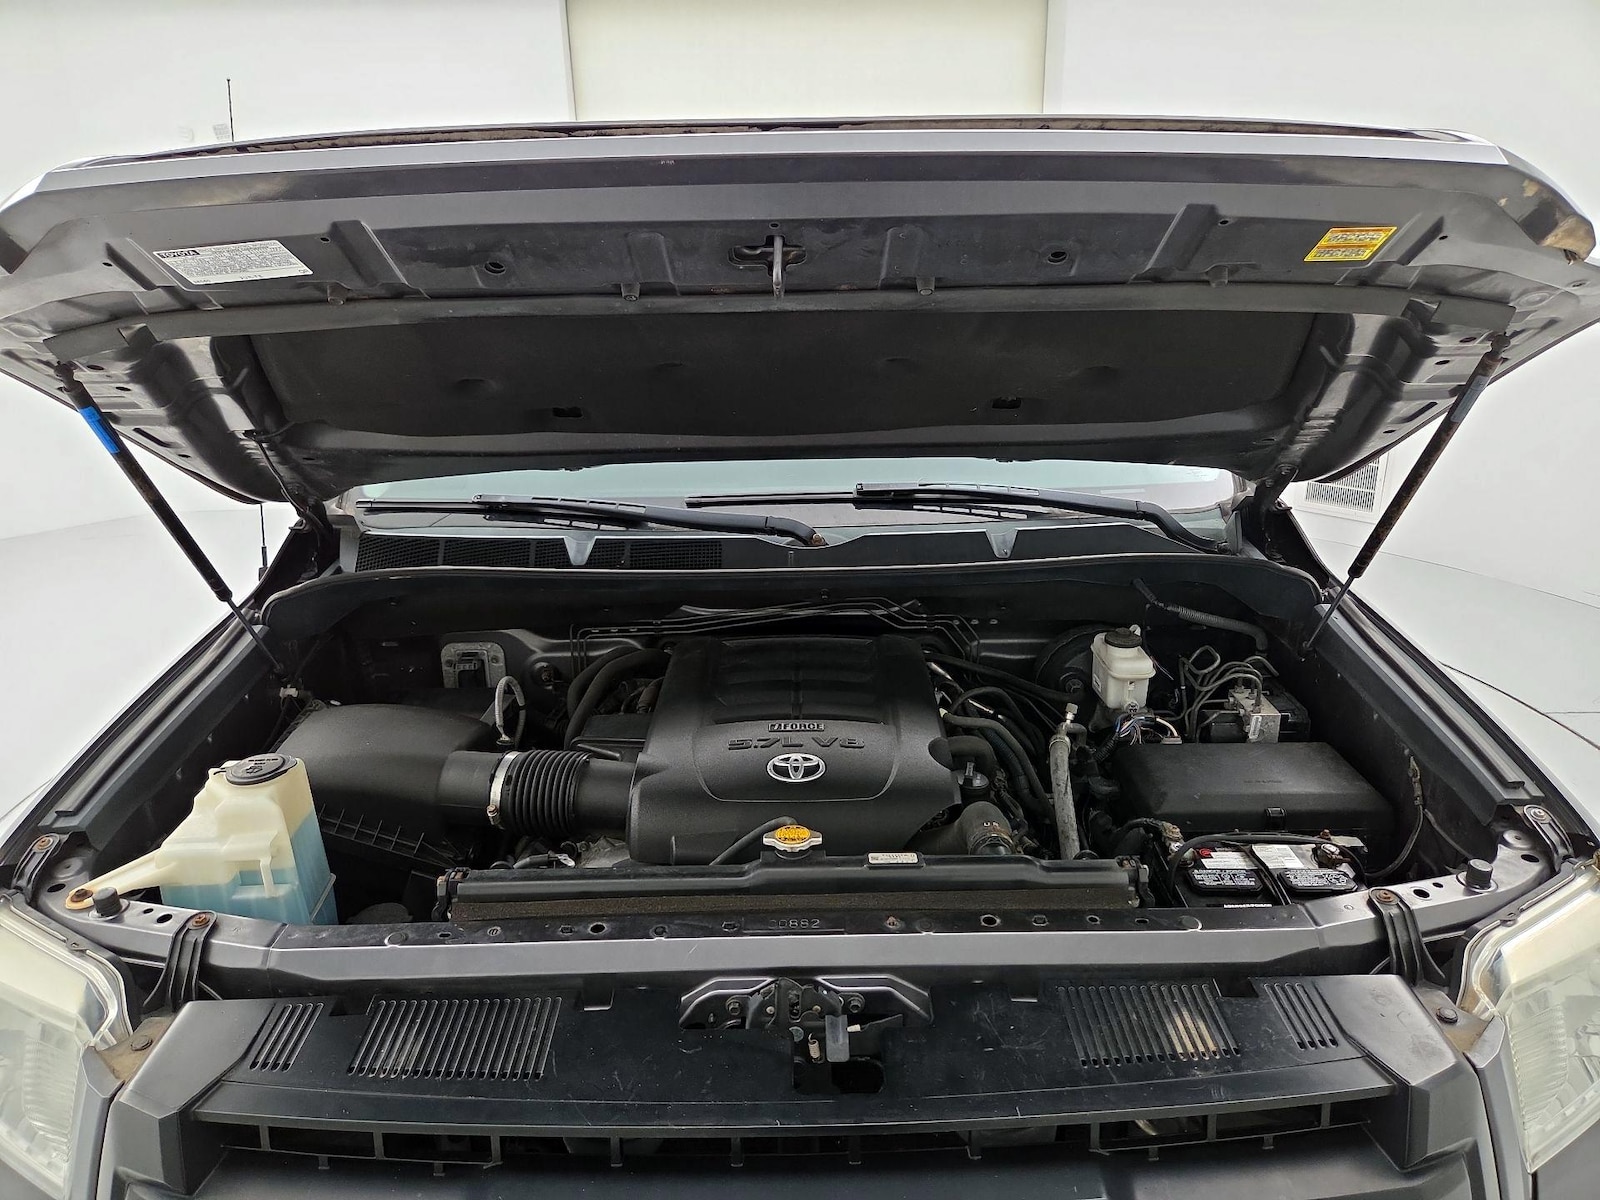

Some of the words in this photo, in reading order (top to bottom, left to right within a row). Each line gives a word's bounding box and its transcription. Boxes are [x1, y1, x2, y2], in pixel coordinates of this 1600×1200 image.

[160, 249, 197, 258] TOYOTA
[728, 736, 803, 750] 5.7L
[811, 736, 865, 749] V8
